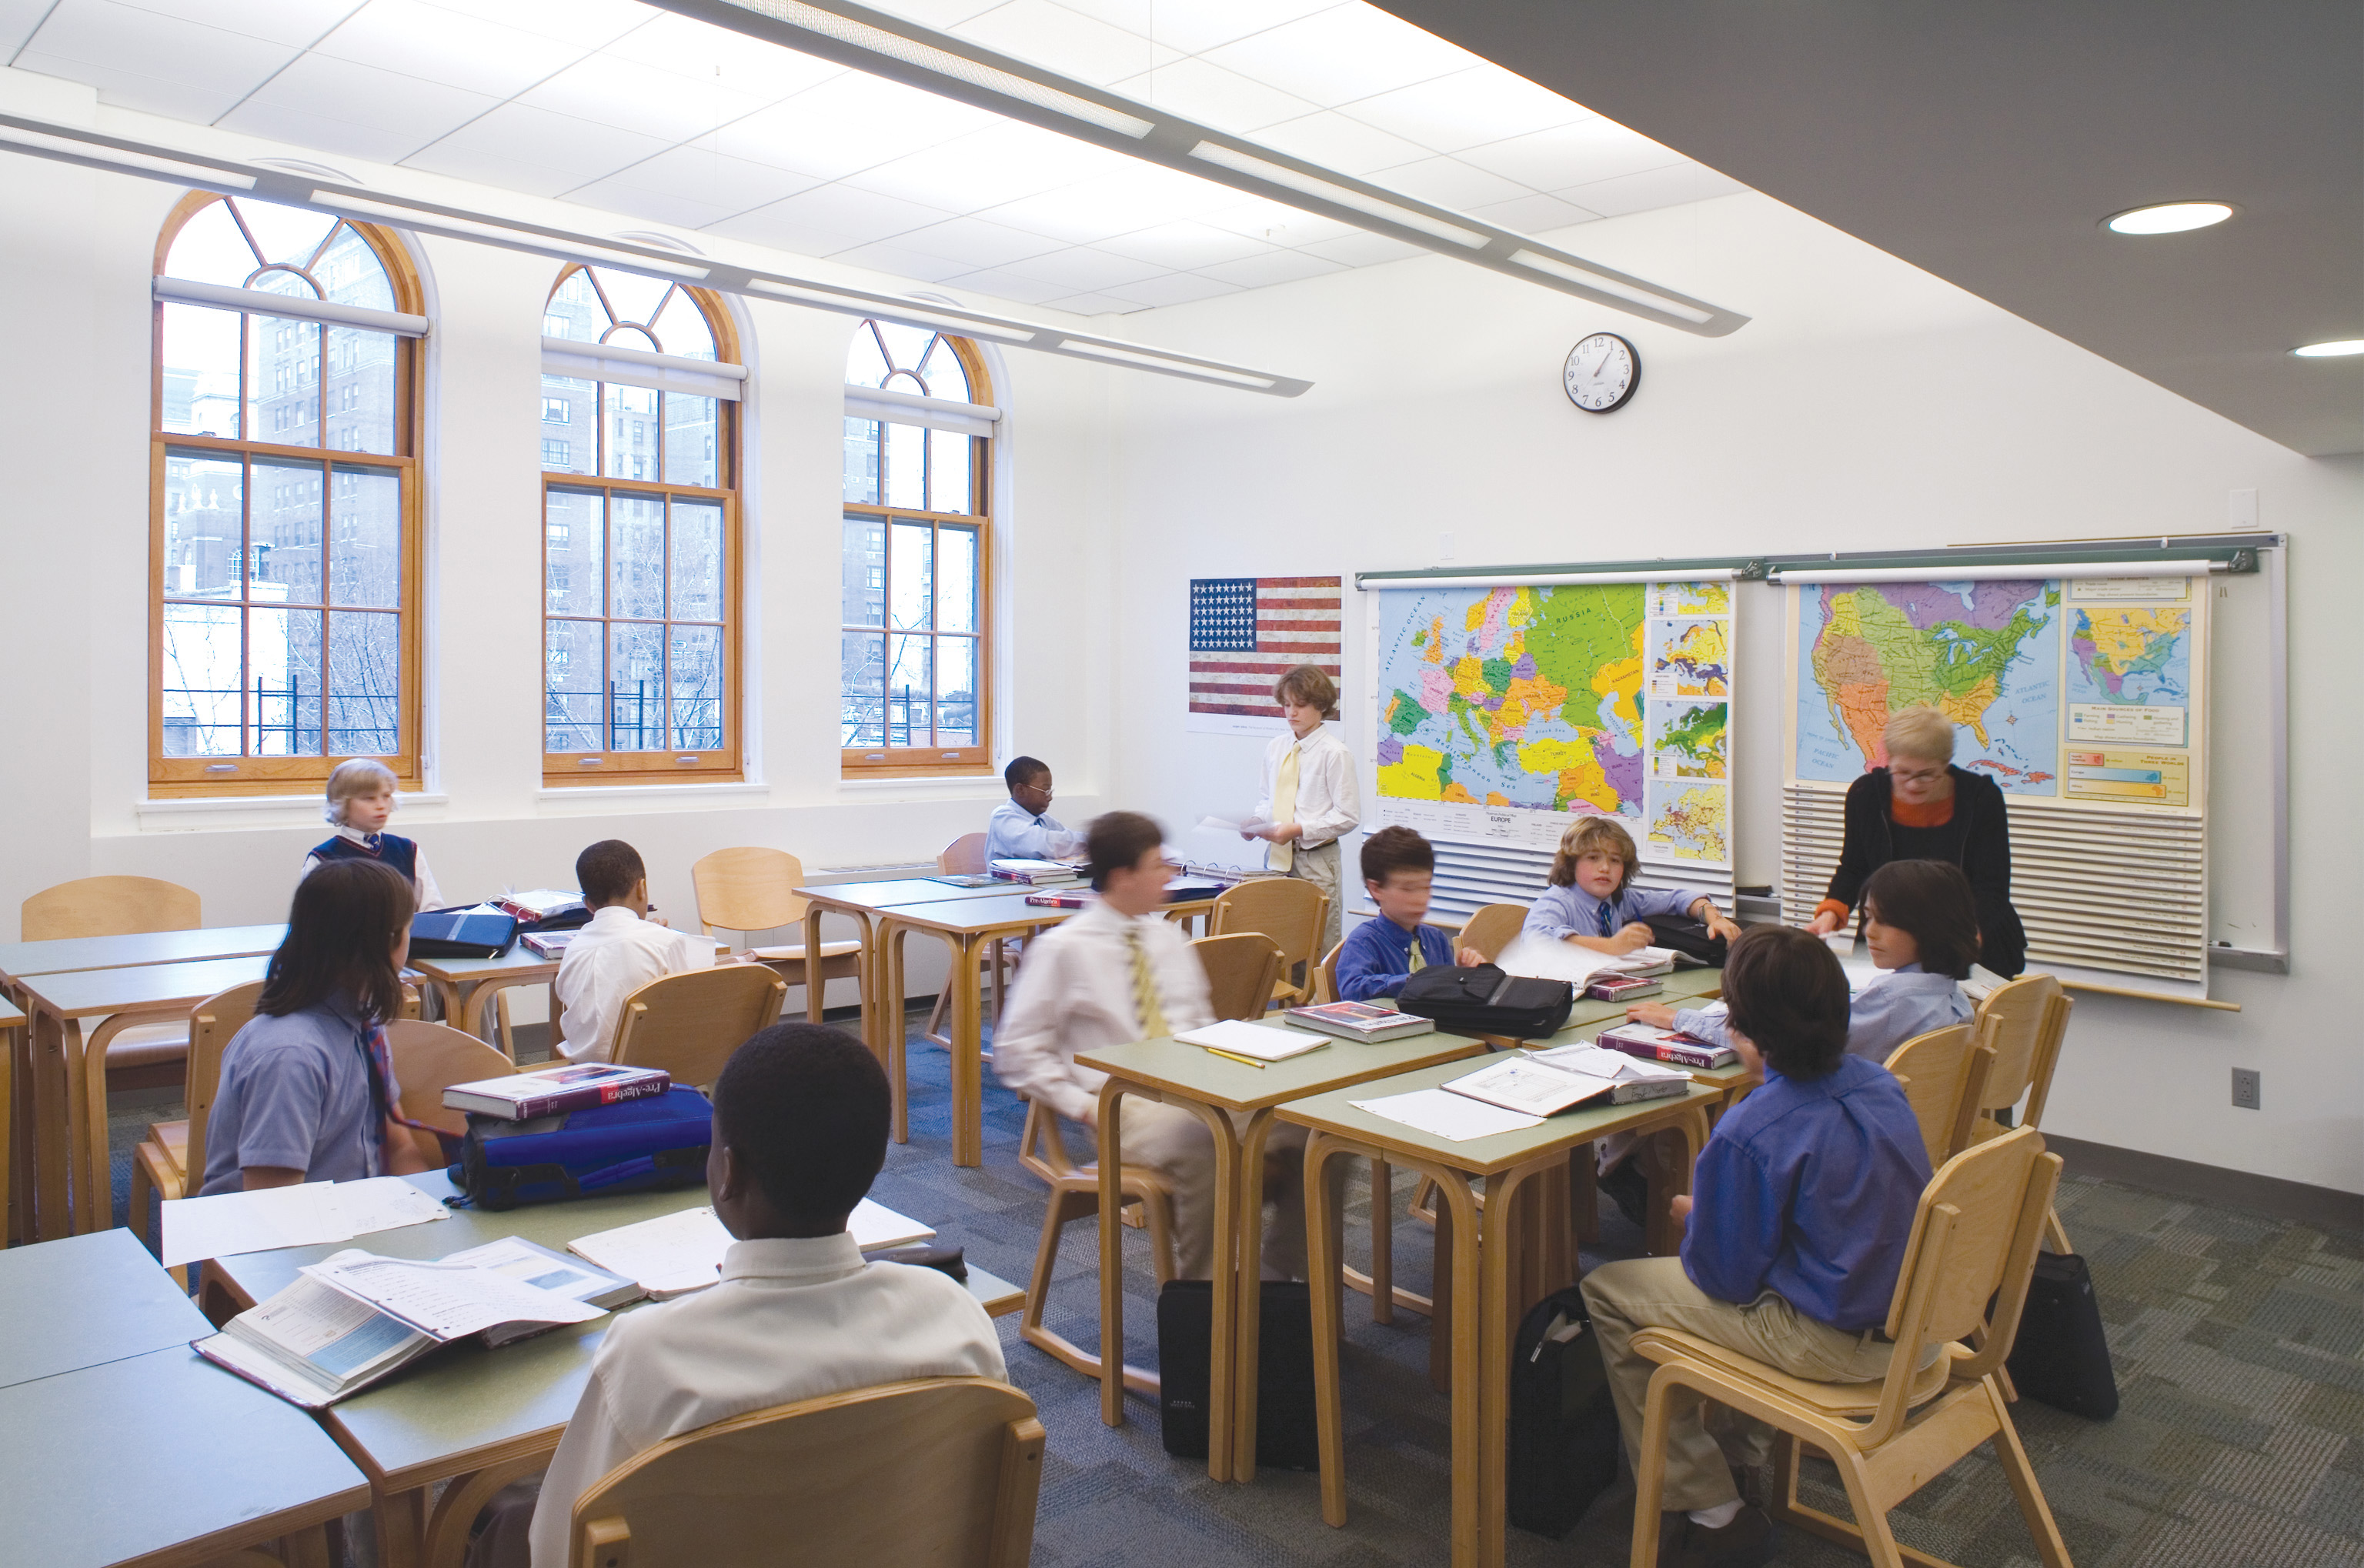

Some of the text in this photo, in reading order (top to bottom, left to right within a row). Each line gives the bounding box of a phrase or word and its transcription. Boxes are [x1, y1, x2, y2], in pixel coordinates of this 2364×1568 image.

[1594, 337, 1604, 348] 12
[1610, 341, 1614, 351] 1
[1582, 345, 1589, 354] 11
[1571, 356, 1579, 365] 10
[1619, 351, 1624, 360] 2
[1624, 365, 1630, 374] 3
[1568, 371, 1574, 381] 9
[1619, 379, 1625, 389] 4
[1571, 385, 1578, 394] 8
[1582, 395, 1588, 405] 7
[1595, 397, 1601, 406] 6
[1608, 392, 1614, 402] 5
[1556, 608, 1591, 624] RUSSIA
[1385, 596, 1425, 672] ATLANTIC OCEAN
[1612, 669, 1639, 683] KAZAKHSTAN
[2015, 680, 2050, 694] ATLANTIC
[2022, 694, 2047, 704] OCEAN
[1814, 748, 1839, 759] PACIFIC
[1434, 737, 1491, 783] Mediterranean
[1811, 758, 1835, 769] OCEAN
[1411, 772, 1425, 782] ALGERIA
[1661, 1051, 1705, 1068] Pre-Algebra
[608, 1082, 661, 1100] Pre-Algebra
